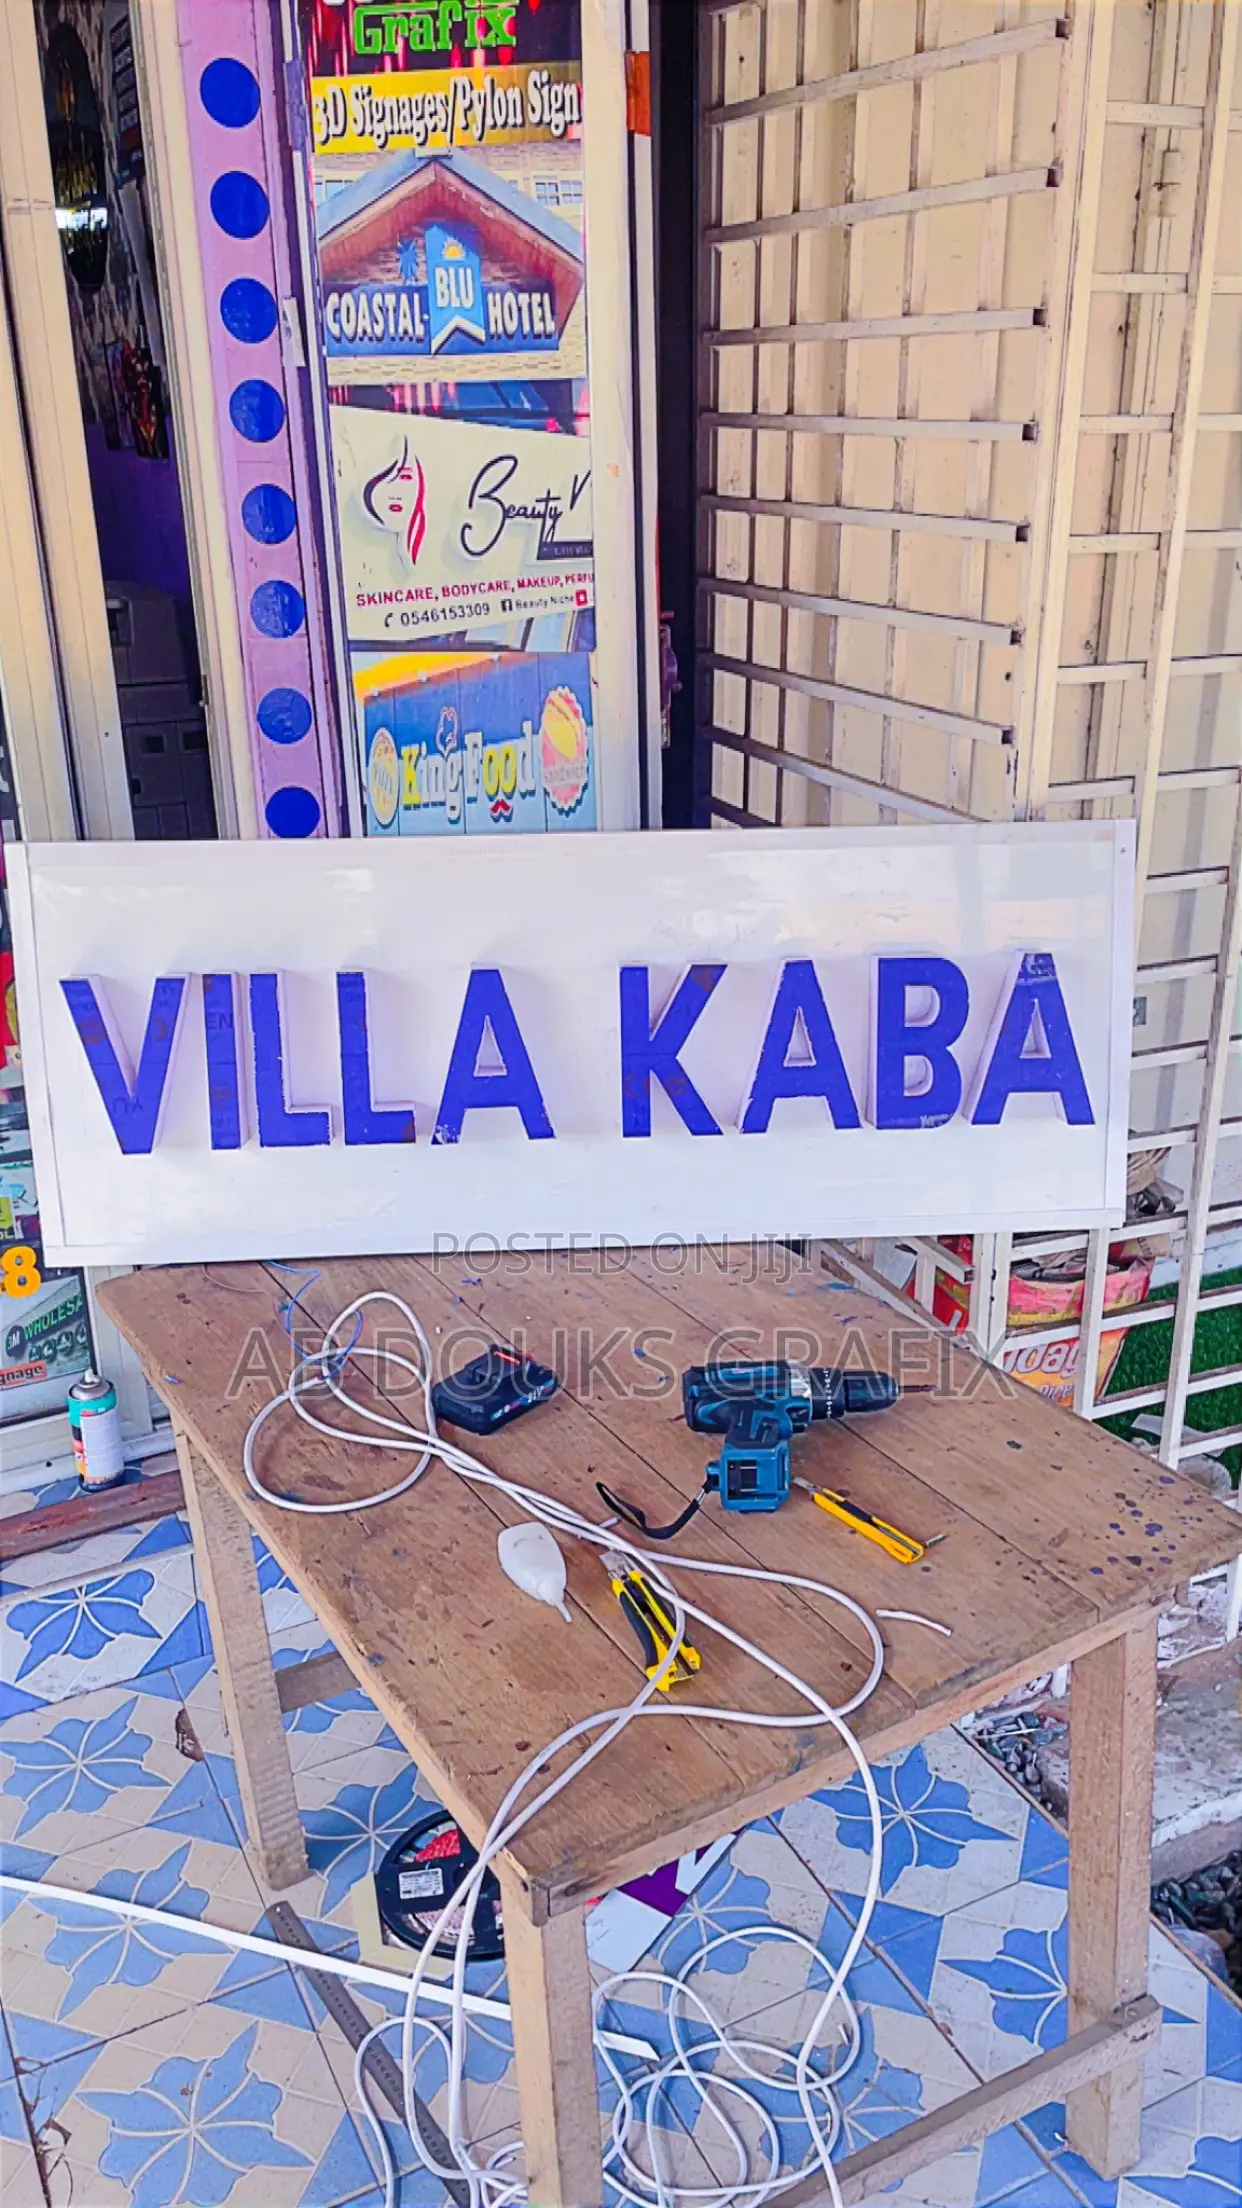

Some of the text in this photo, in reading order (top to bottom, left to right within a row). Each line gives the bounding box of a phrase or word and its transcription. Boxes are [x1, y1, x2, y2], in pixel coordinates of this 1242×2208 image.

[354, 1, 516, 54] Grafix
[314, 86, 347, 146] 3D
[435, 267, 473, 309] BLU
[487, 292, 556, 340] HOTEL
[461, 455, 563, 556] Beauty
[356, 587, 439, 607] SKINCARE,
[441, 579, 515, 598] BODYCARE,
[517, 575, 564, 589] MAKEUP,
[400, 602, 491, 627] 0546153309
[59, 952, 1097, 1155] VILLA KABA
